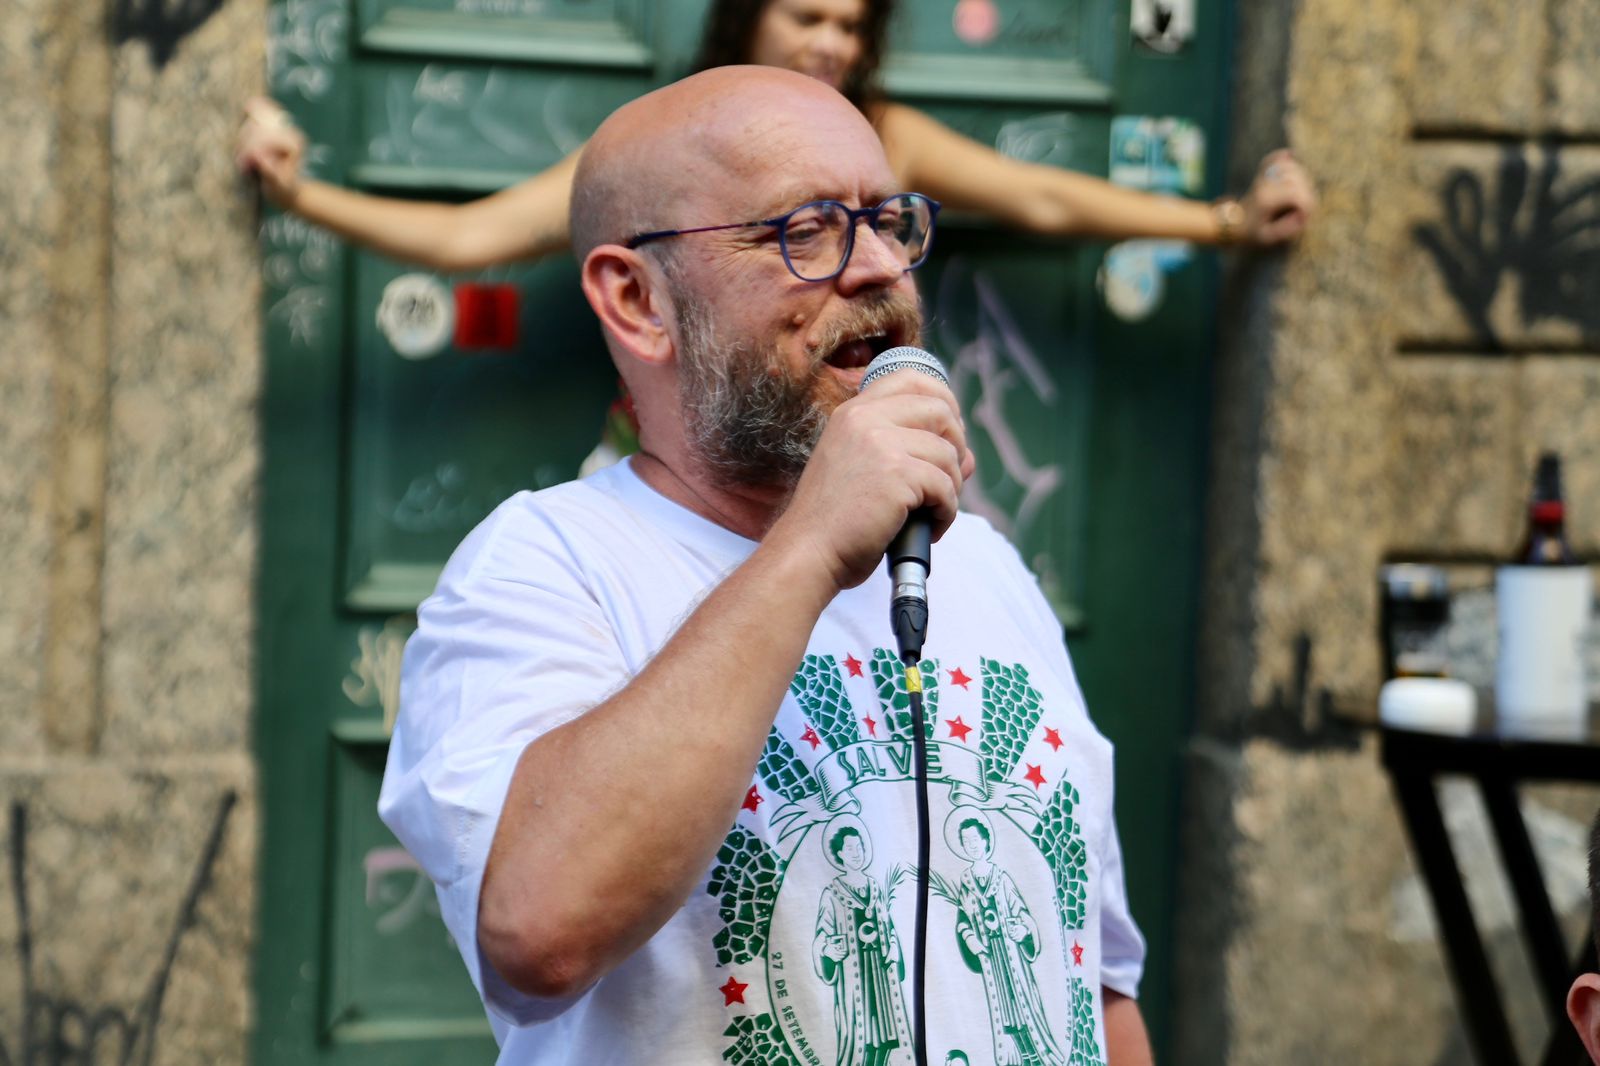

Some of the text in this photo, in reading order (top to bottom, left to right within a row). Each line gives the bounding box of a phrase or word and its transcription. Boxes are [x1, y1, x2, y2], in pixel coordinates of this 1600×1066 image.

[836, 743, 942, 782] SALVE
[771, 951, 824, 1066] 27 DE SETEMBR
